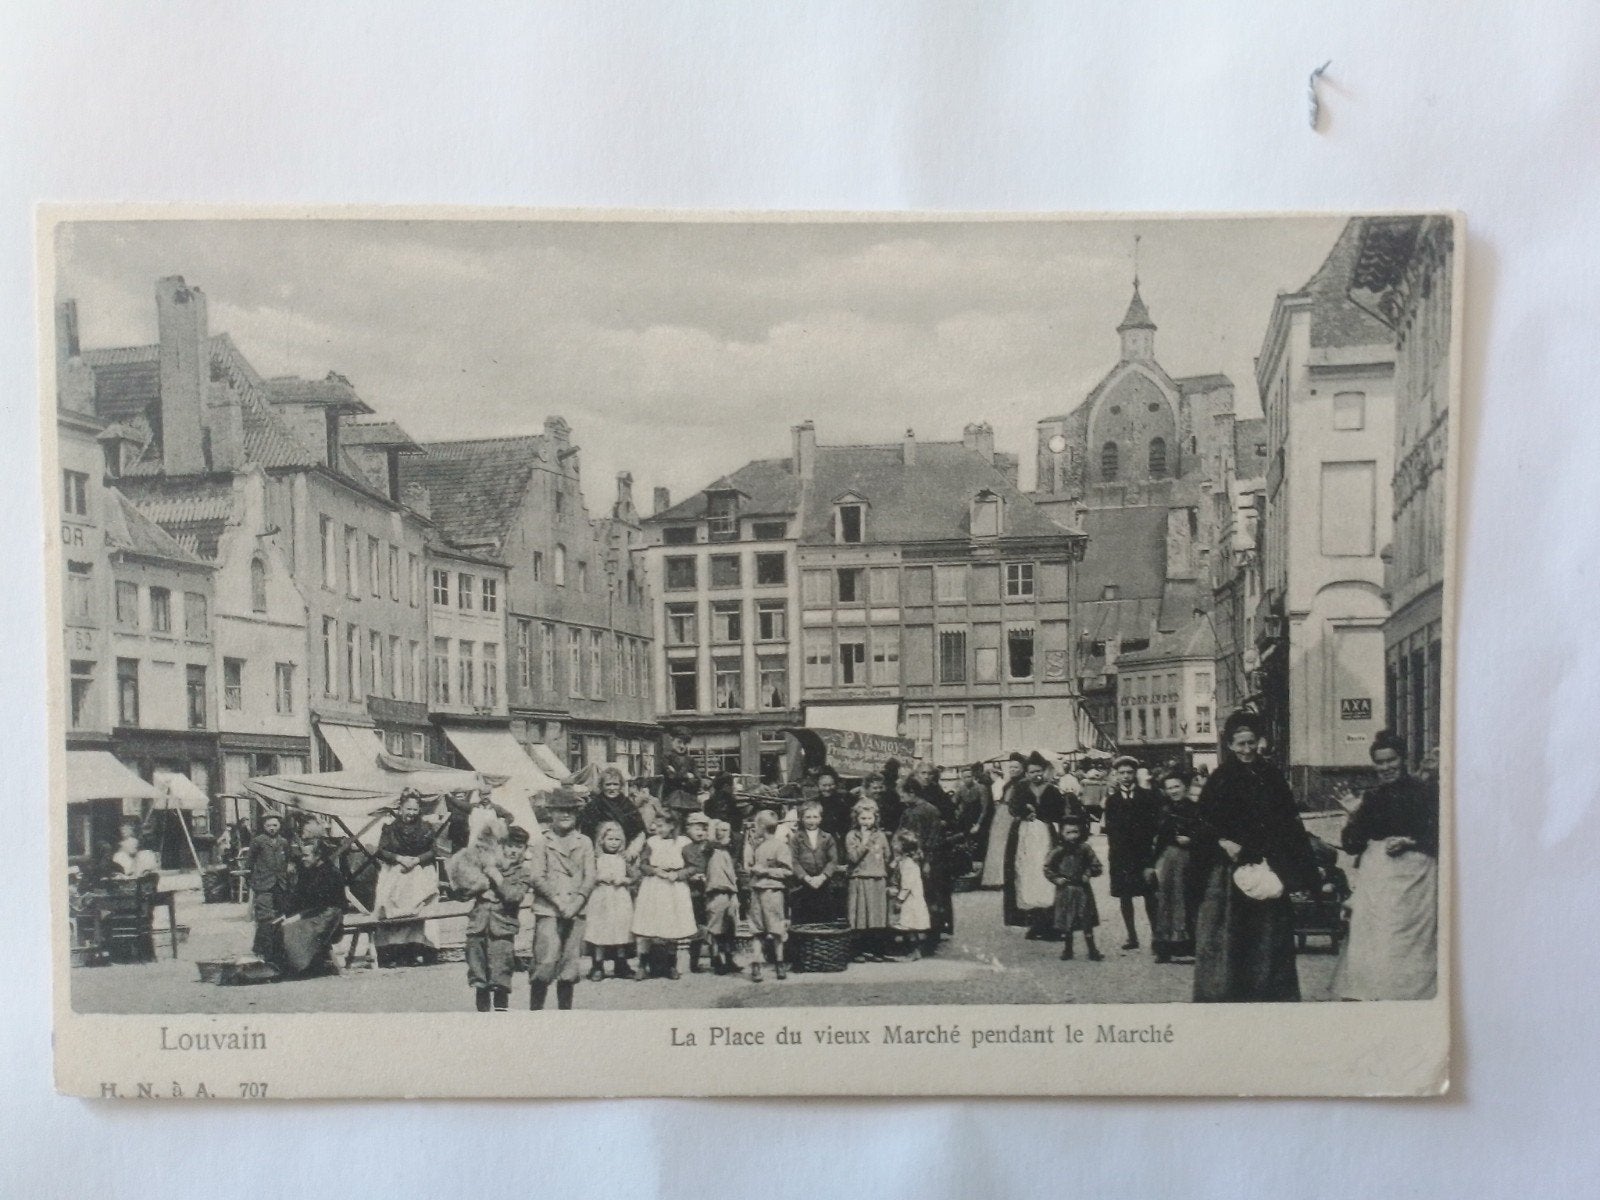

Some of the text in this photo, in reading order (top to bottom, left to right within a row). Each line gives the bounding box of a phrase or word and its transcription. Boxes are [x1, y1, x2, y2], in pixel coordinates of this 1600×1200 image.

[1342, 700, 1370, 711] AXA
[160, 1026, 267, 1050] Louvain
[670, 1023, 1174, 1049] La Place du vieux Marché pendant le Marché
[100, 1080, 269, 1098] H. N. à A. 707
